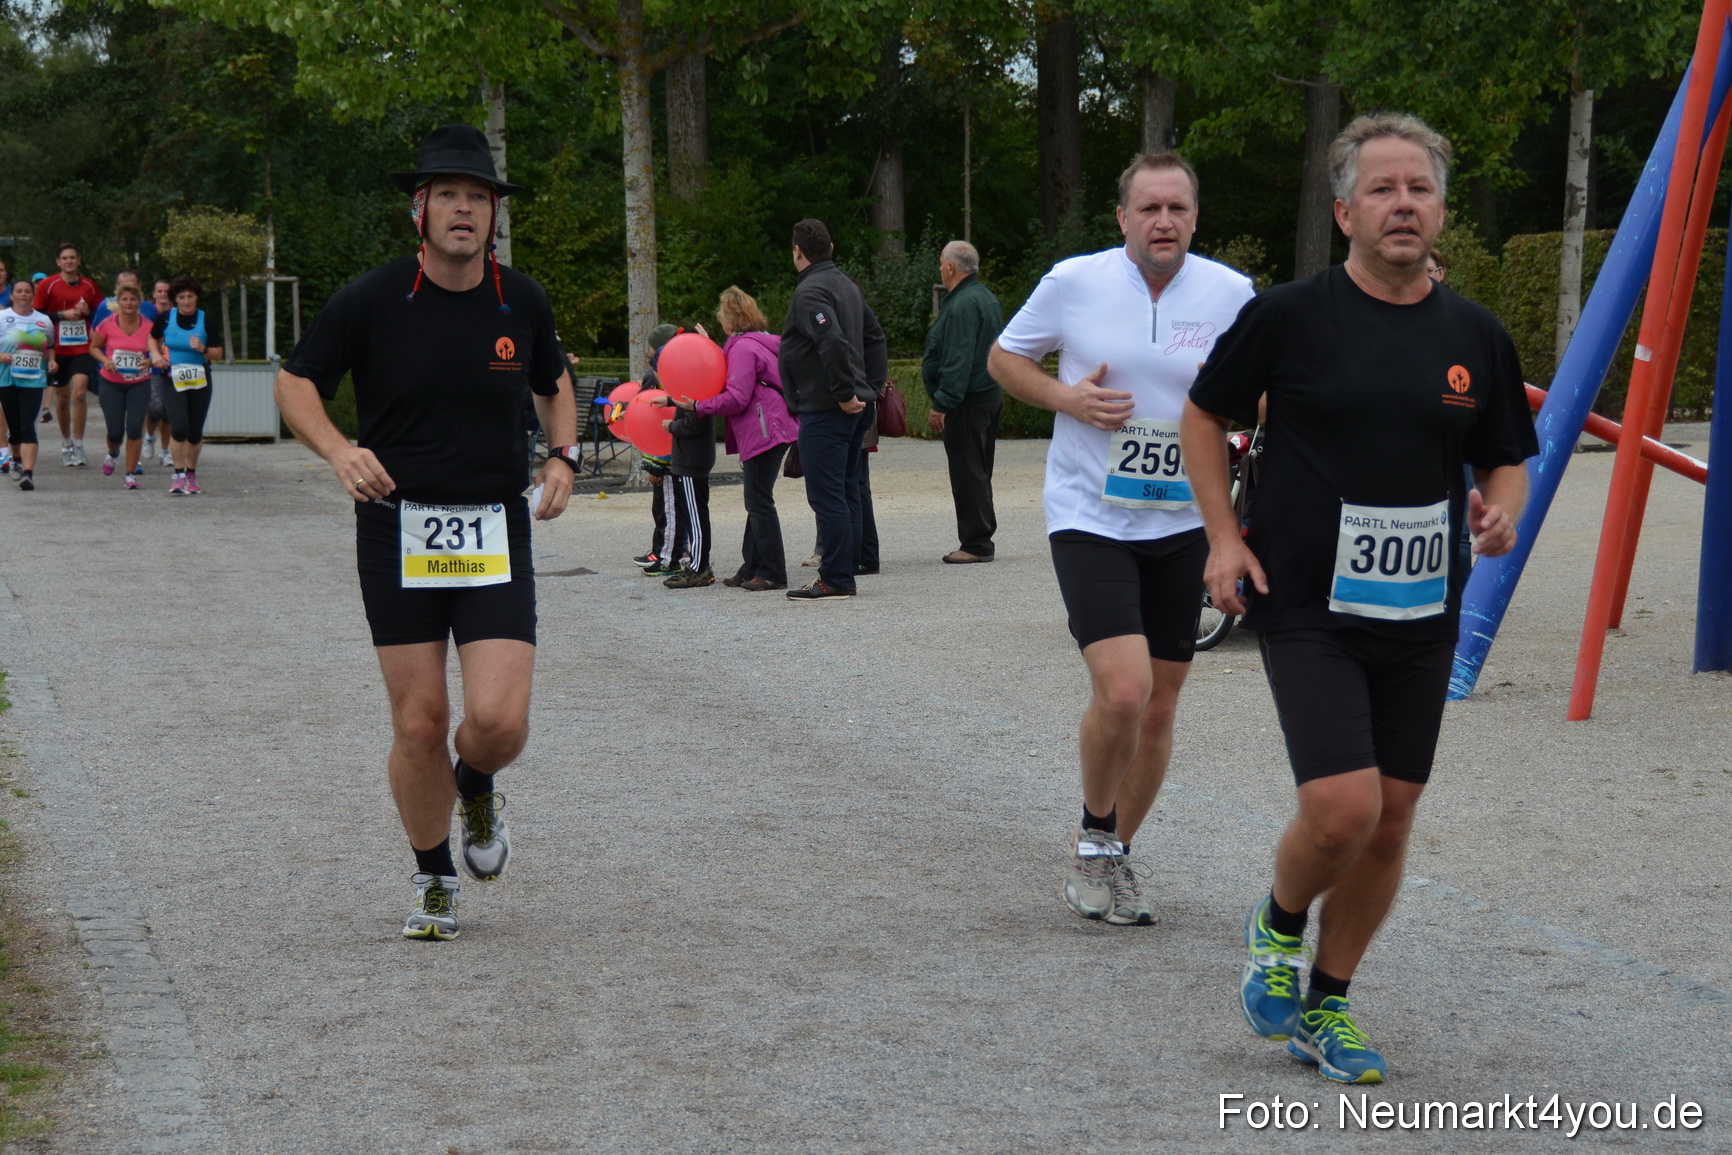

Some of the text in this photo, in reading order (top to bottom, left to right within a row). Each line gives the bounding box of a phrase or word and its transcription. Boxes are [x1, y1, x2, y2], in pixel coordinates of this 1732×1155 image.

[62, 326, 85, 336] 2123
[1164, 321, 1216, 355] Julia
[15, 356, 40, 368] 2582
[178, 368, 198, 380] 307
[1117, 440, 1187, 477] 259
[1143, 484, 1169, 500] Sigi
[374, 499, 396, 510] SPIRO
[404, 503, 489, 513] PARTL Neumarkt
[1344, 515, 1439, 530] PARTL Neumarkt
[423, 516, 484, 550] 231
[1350, 532, 1443, 576] 3000
[427, 559, 486, 574] Matthias
